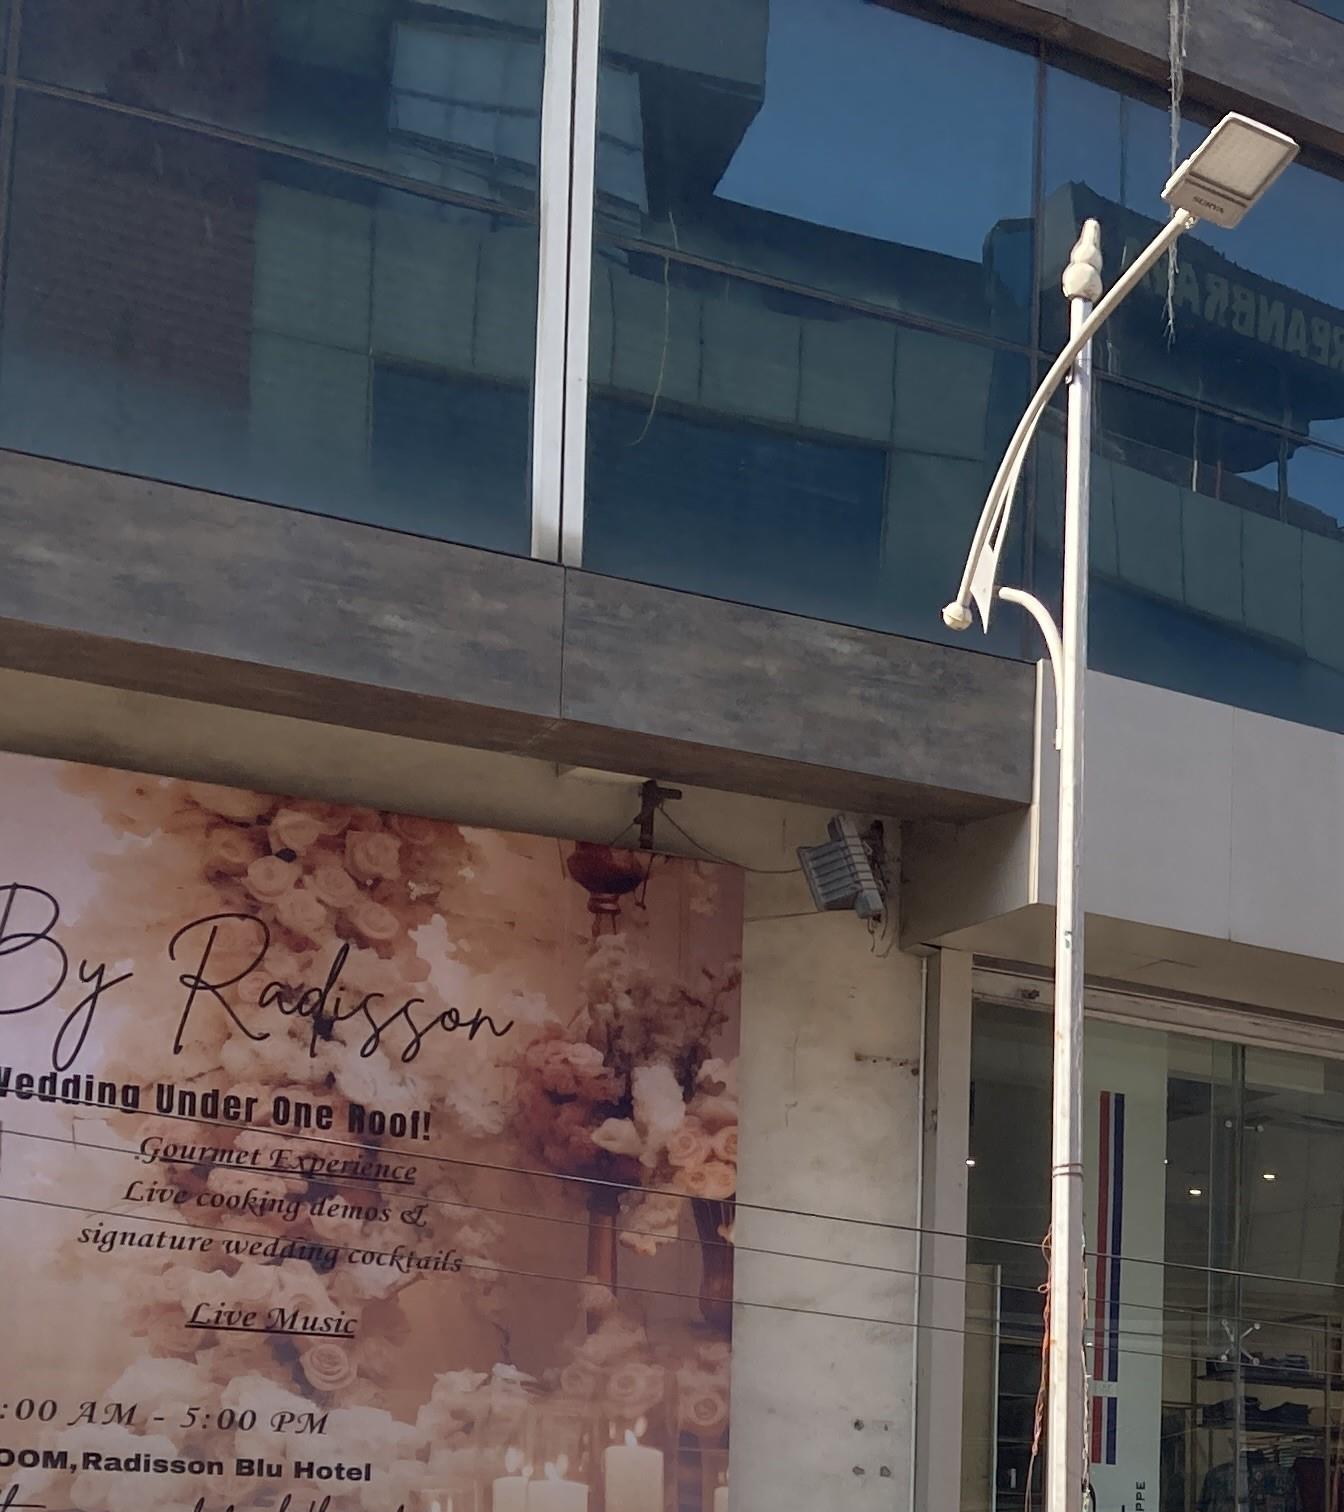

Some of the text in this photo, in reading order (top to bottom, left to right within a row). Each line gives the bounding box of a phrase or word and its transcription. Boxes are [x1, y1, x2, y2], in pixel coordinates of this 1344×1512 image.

[0, 882, 515, 1071] By Radisson
[156, 1083, 258, 1123] Under
[272, 1094, 334, 1131] One
[348, 1104, 432, 1141] Roof!
[139, 1136, 418, 1182] Gourmet Experience
[124, 1180, 188, 1205] Live
[196, 1188, 304, 1222] cooking
[309, 1194, 392, 1223] demos
[78, 1223, 463, 1274] signature wedding cocktails
[188, 1302, 359, 1335] Live Music
[67, 1401, 138, 1427] AM
[180, 1407, 257, 1431] 5:00
[270, 1409, 329, 1436] PM
[235, 1458, 283, 1479] Blu
[294, 1461, 373, 1482] Hotel
